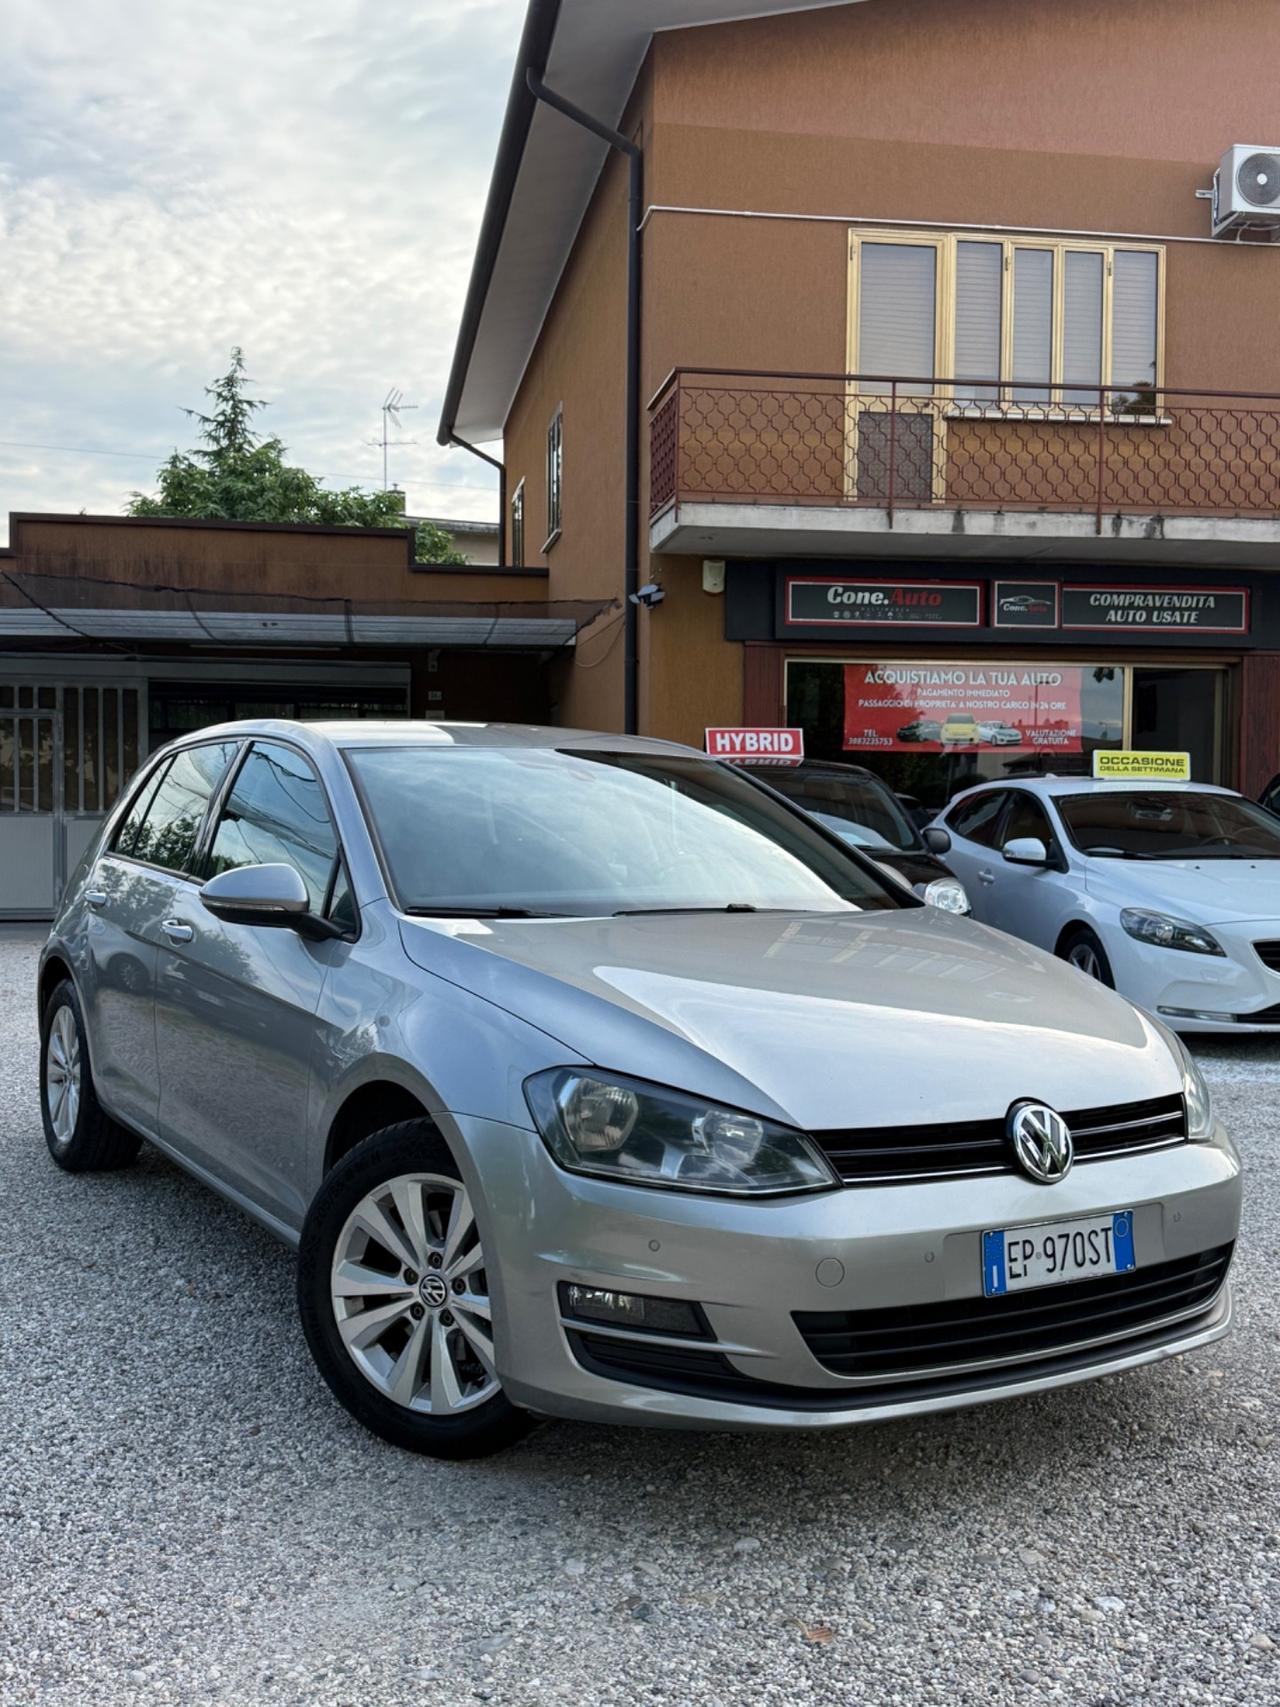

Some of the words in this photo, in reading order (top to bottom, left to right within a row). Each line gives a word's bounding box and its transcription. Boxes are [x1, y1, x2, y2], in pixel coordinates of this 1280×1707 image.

[827, 586, 942, 606] Cone.Auto
[1090, 593, 1215, 608] COMPRAVENDITA
[1106, 609, 1147, 623] AUTO
[1152, 610, 1199, 624] USATE
[864, 670, 965, 684] ACQUISTIAMO
[970, 672, 986, 685] LA
[990, 672, 1017, 686] TUA
[1021, 673, 1062, 686] AUTO
[917, 688, 964, 697] PAGAMENTO
[966, 689, 1010, 698] IMMEDIATO
[858, 699, 902, 708] PASSAGGIO
[966, 701, 999, 709] NOSTRO
[1001, 701, 1029, 709] CARICO
[1050, 702, 1066, 710] ORE
[1025, 729, 1076, 737] VALUTAZIONE
[716, 733, 794, 752] HYBRID
[1033, 737, 1069, 745] GRATUITA
[1100, 756, 1185, 767] OCCASIONE
[1131, 766, 1185, 774] SETTIMANA
